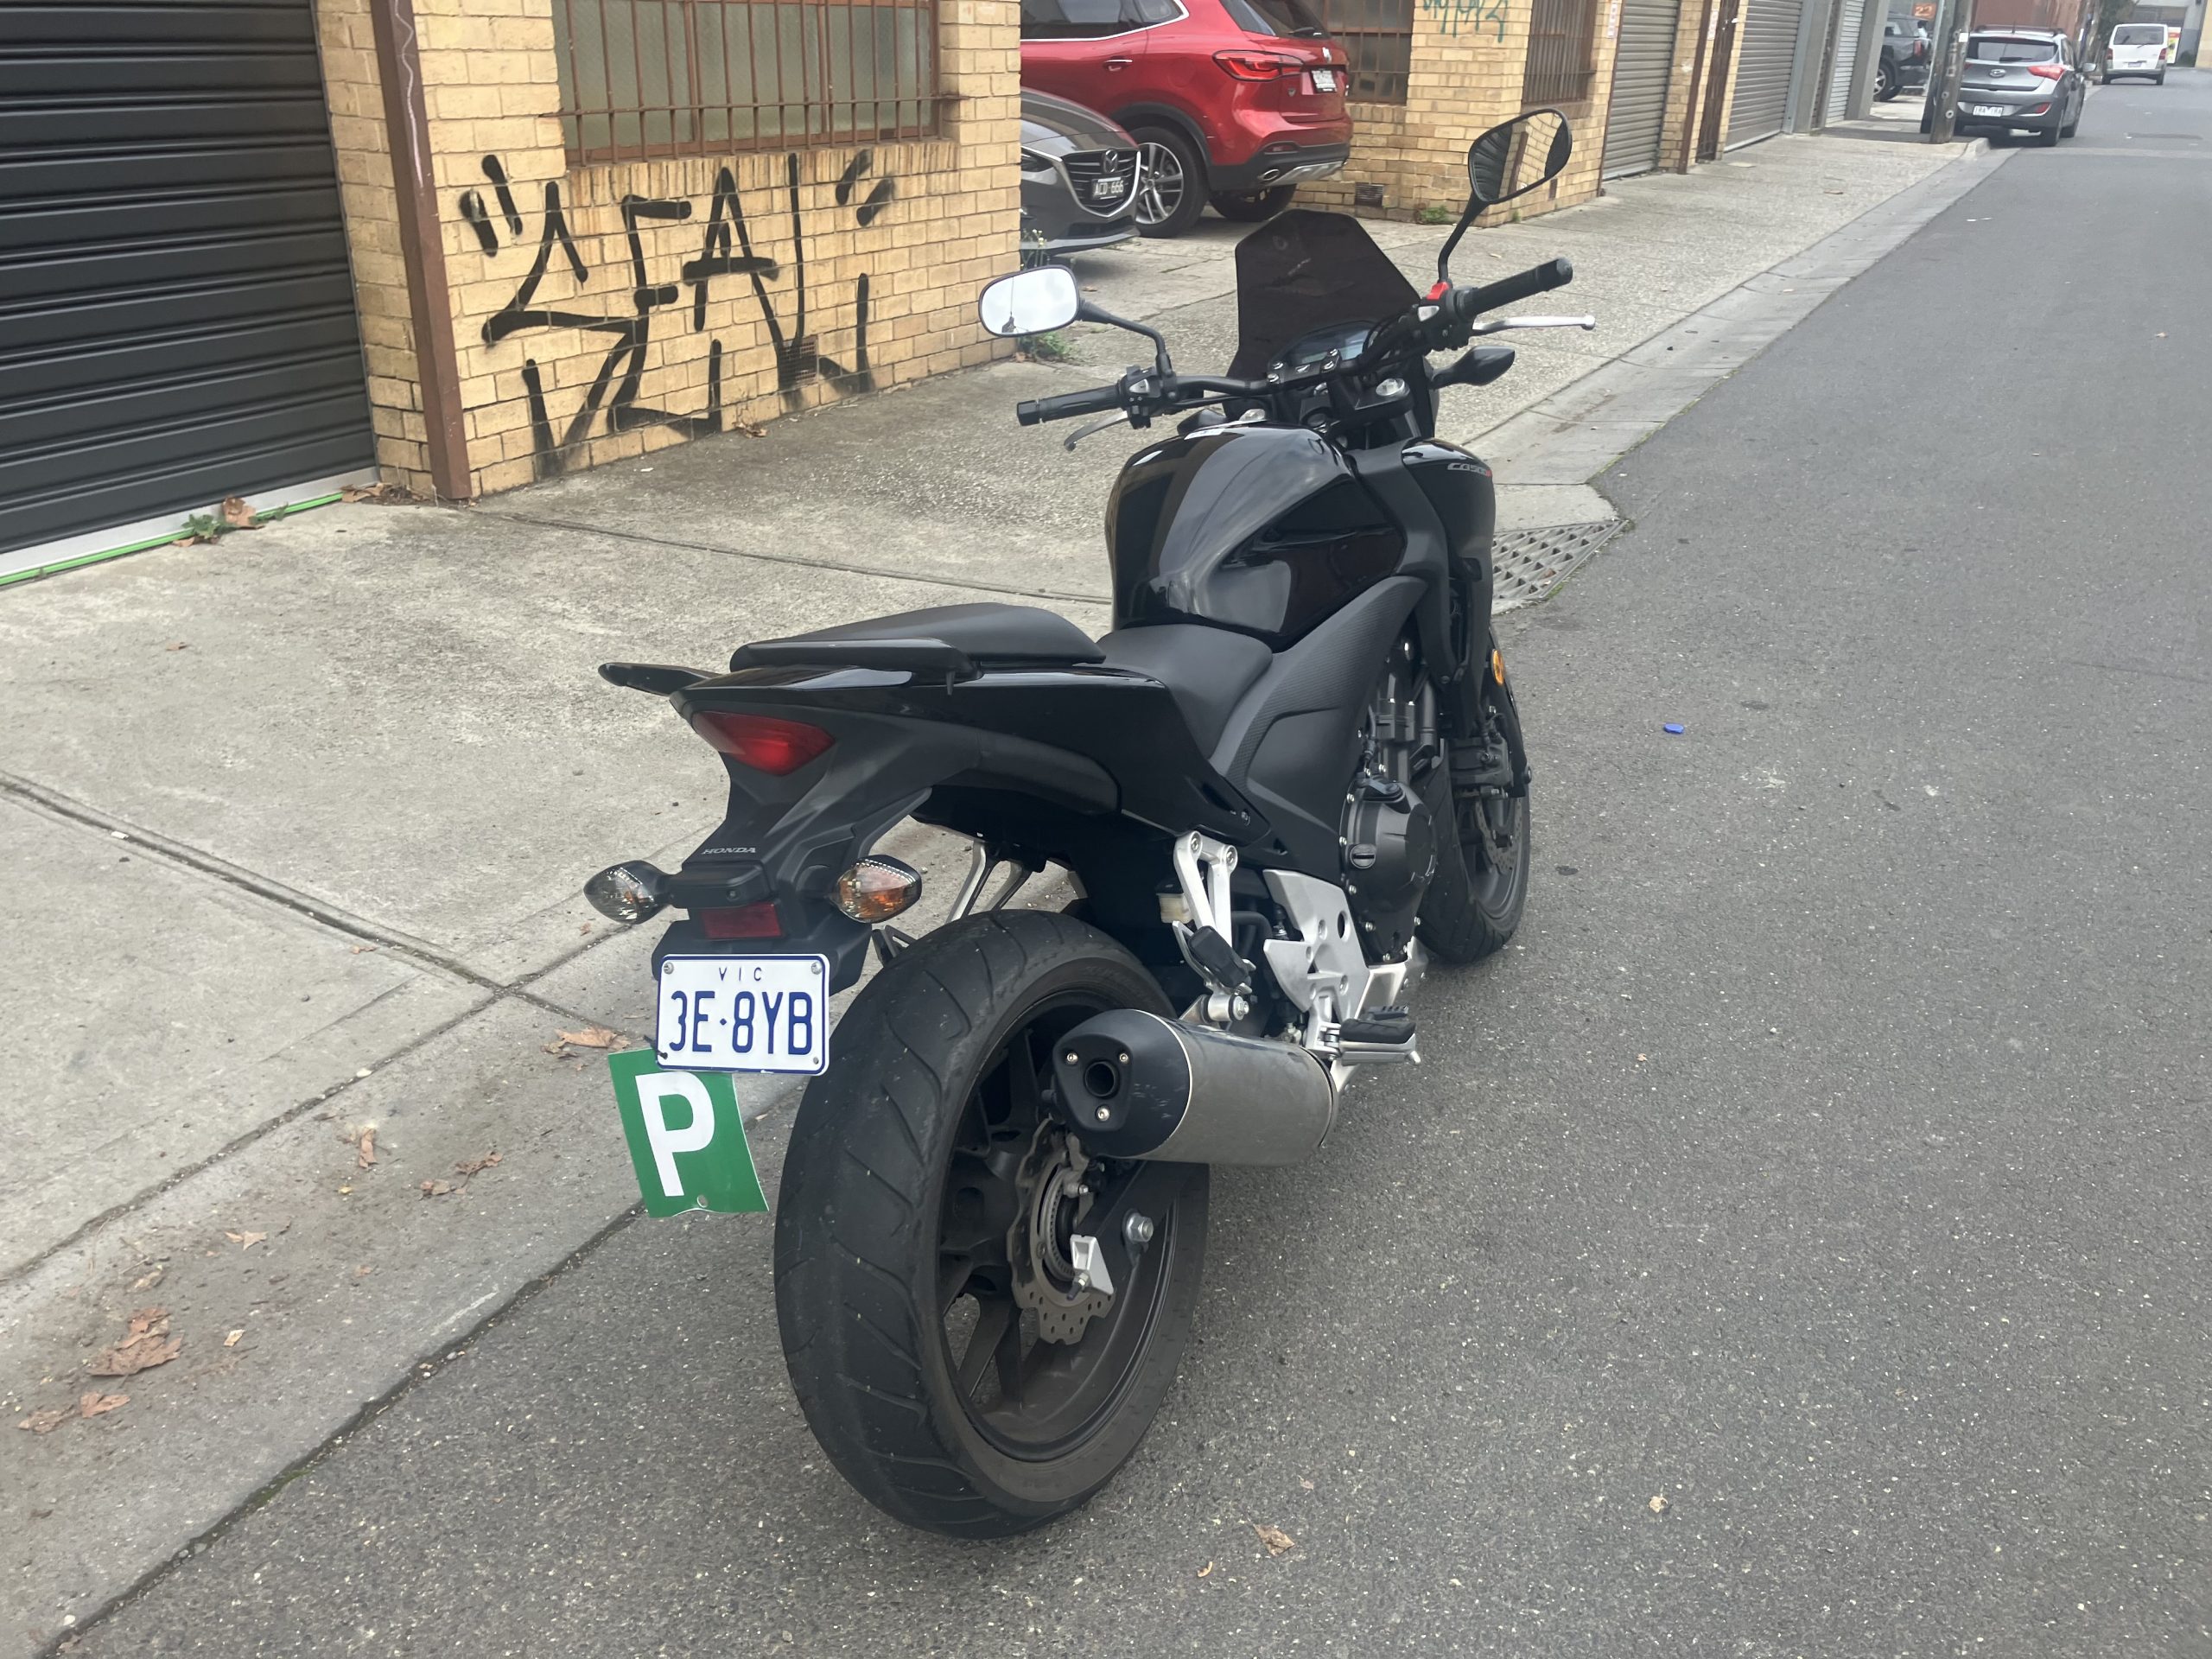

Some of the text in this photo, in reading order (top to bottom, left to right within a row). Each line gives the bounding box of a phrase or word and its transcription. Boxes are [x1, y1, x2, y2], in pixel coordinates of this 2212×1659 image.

[1915, 5, 1933, 16] 22
[718, 967, 762, 982] VIC
[635, 1071, 715, 1198] P
